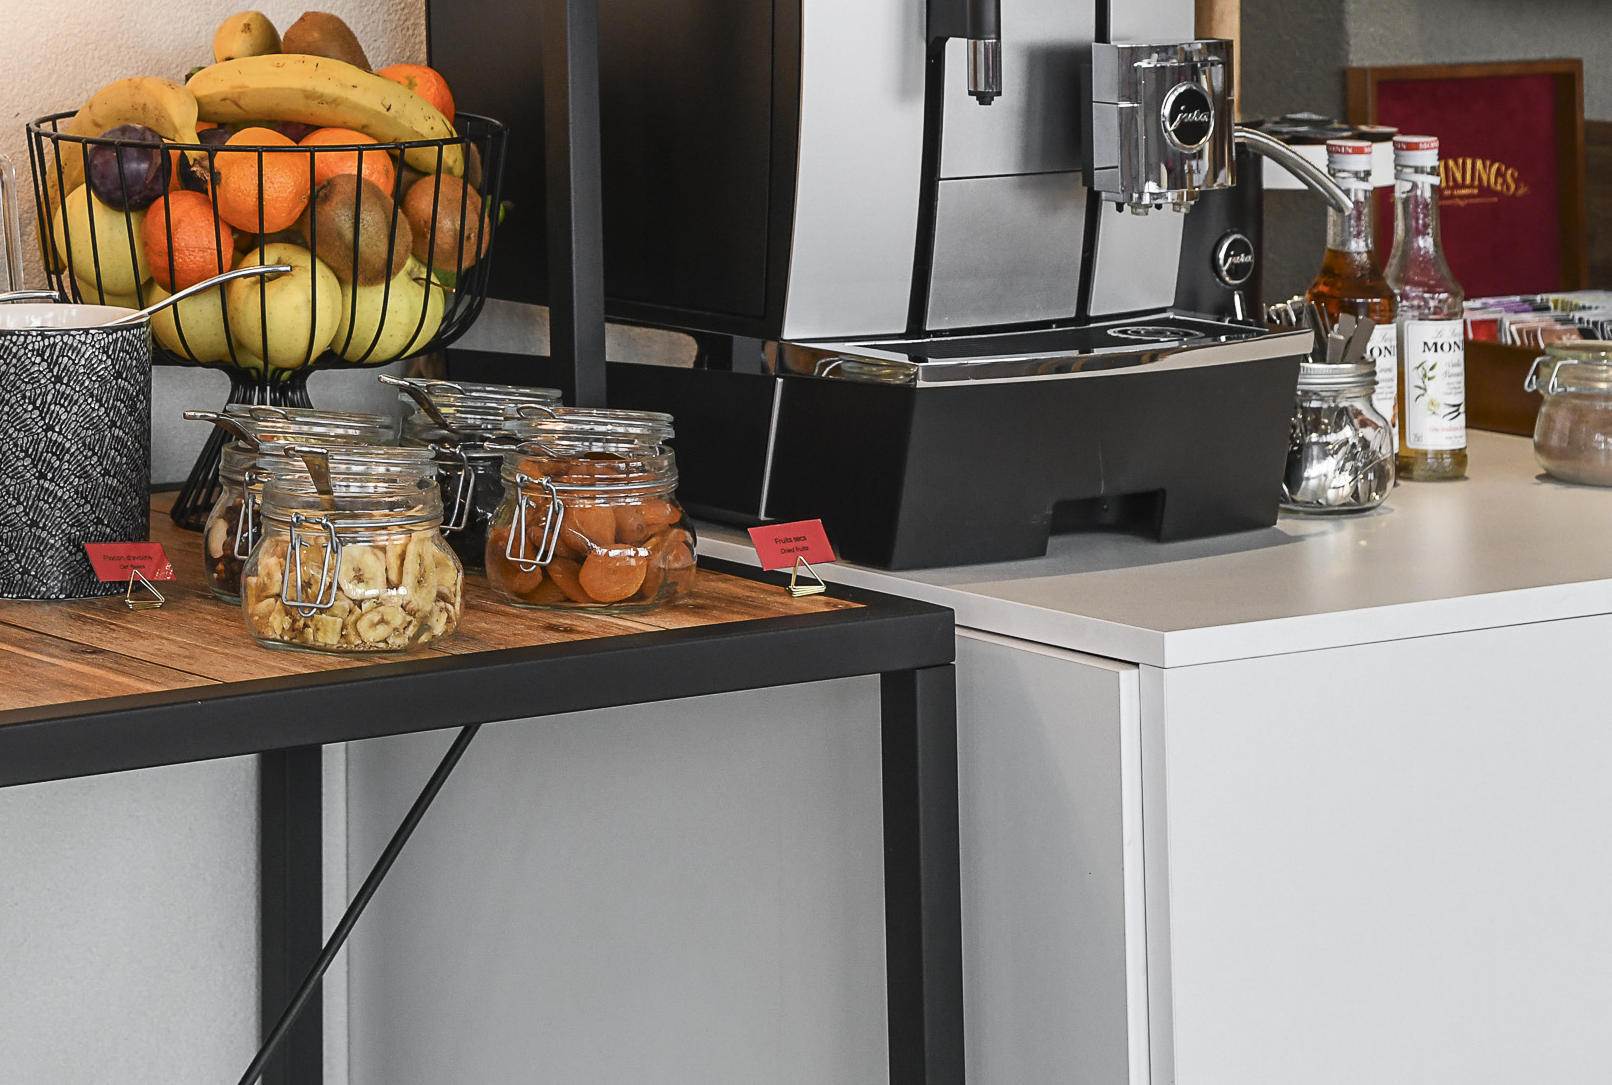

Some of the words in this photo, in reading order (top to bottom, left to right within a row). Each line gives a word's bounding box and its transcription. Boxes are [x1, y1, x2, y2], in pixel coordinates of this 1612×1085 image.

[1439, 157, 1519, 195] ININGS
[1422, 340, 1464, 353] MONI
[780, 546, 795, 554] Dried
